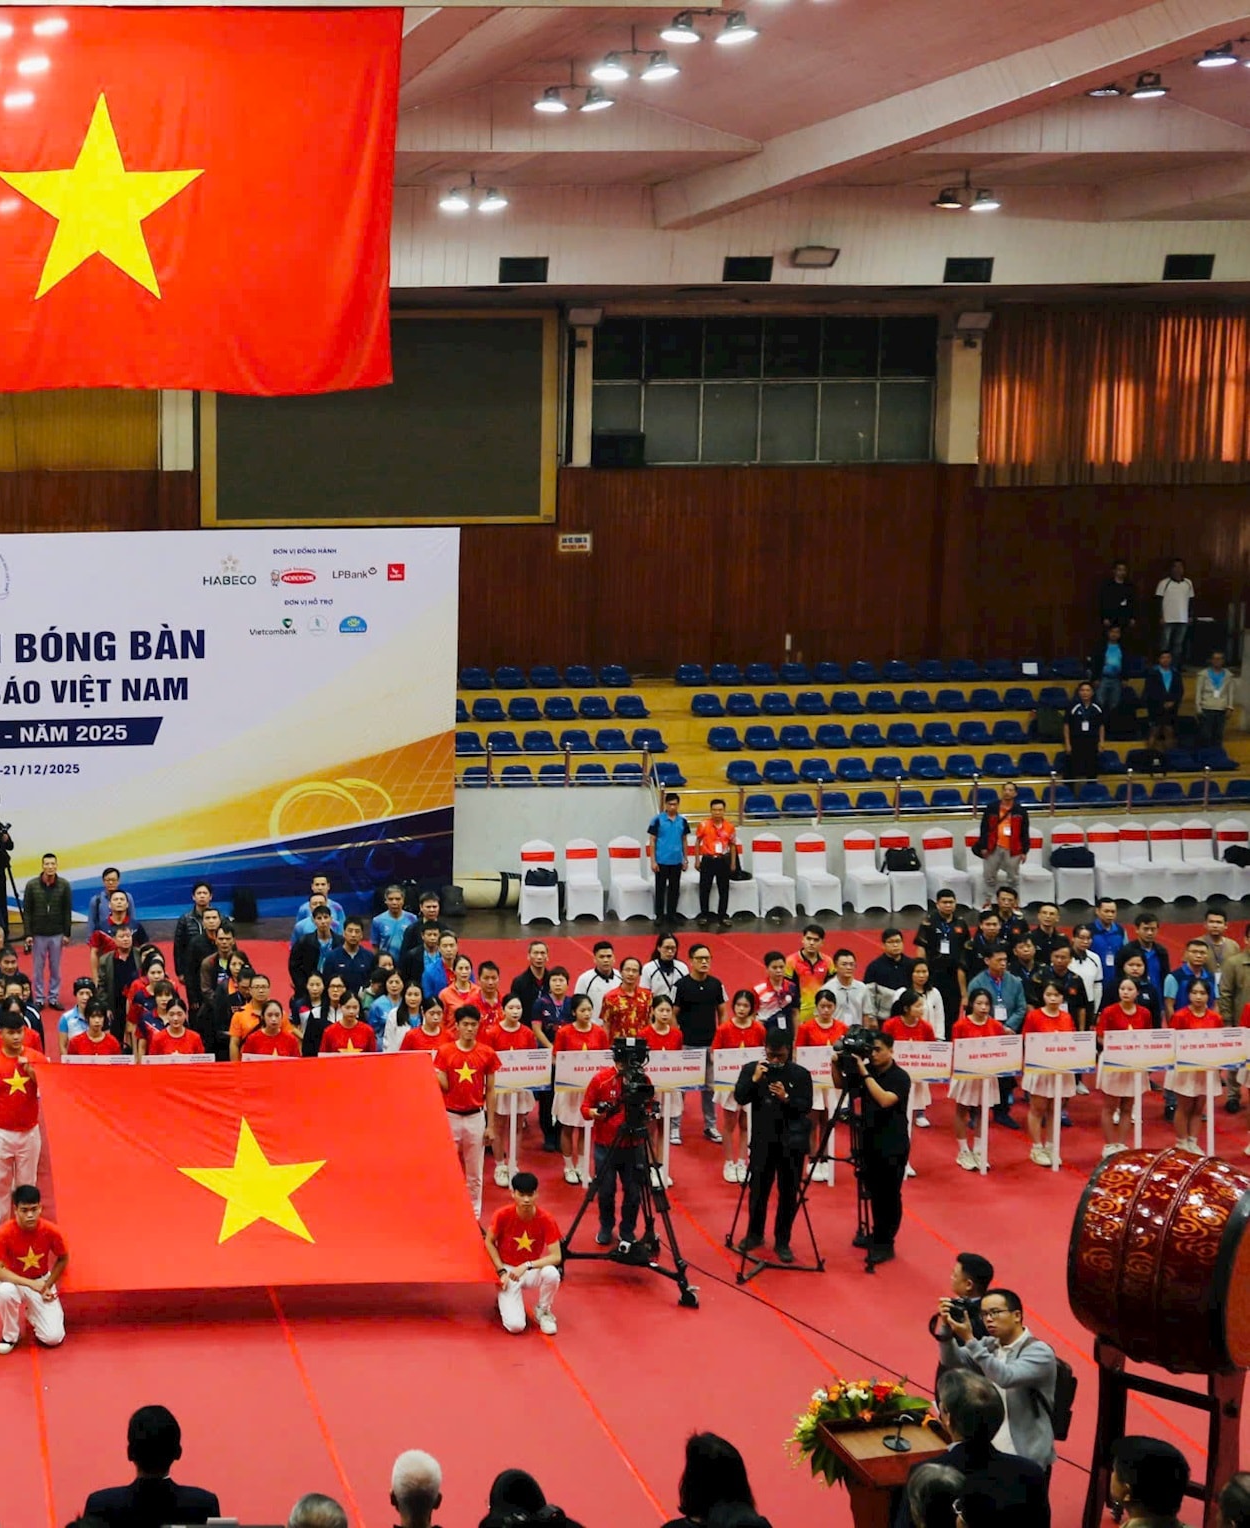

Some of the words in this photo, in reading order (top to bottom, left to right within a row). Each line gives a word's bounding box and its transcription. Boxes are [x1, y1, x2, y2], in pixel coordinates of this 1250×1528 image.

[290, 548, 296, 556] VỊ
[297, 546, 317, 554] ĐỒNG
[202, 575, 257, 586] HABECO
[332, 570, 368, 580] LPBank
[250, 626, 298, 636] Vietcombank
[15, 626, 116, 662] BÓNG
[130, 624, 205, 660] BÀN
[50, 674, 112, 708] VIỆT
[122, 677, 188, 702] NAM
[20, 724, 68, 742] NĂM
[76, 724, 128, 742] 2025
